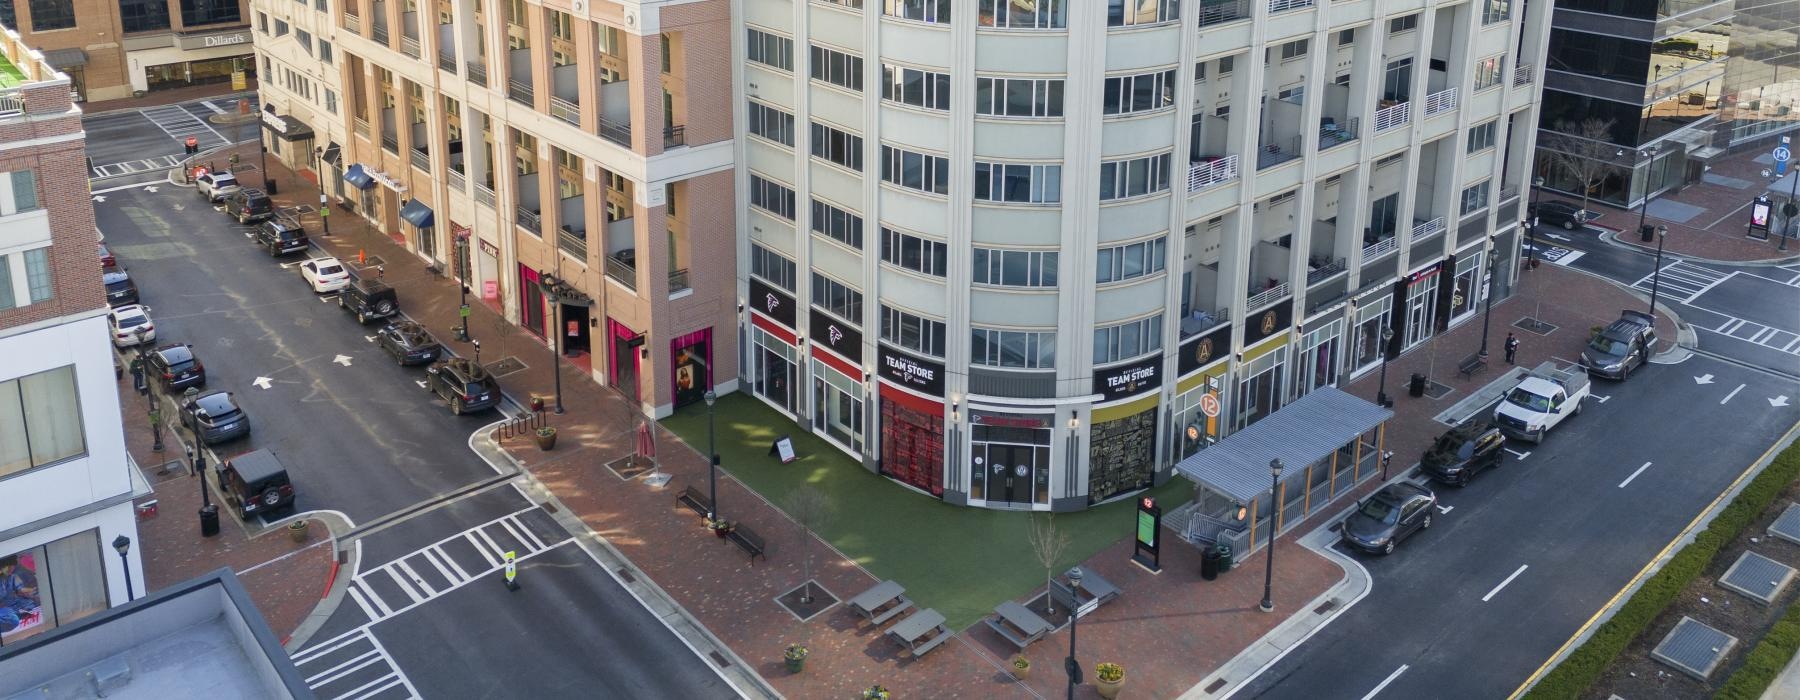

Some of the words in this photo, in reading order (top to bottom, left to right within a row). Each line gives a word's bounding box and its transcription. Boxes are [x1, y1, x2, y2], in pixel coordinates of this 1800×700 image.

[205, 34, 244, 46] Dillard's
[886, 355, 906, 372] TEAM
[908, 364, 934, 380] STORE
[1108, 374, 1130, 388] TEAM
[1132, 366, 1154, 381] STORE
[1203, 397, 1216, 414] 12
